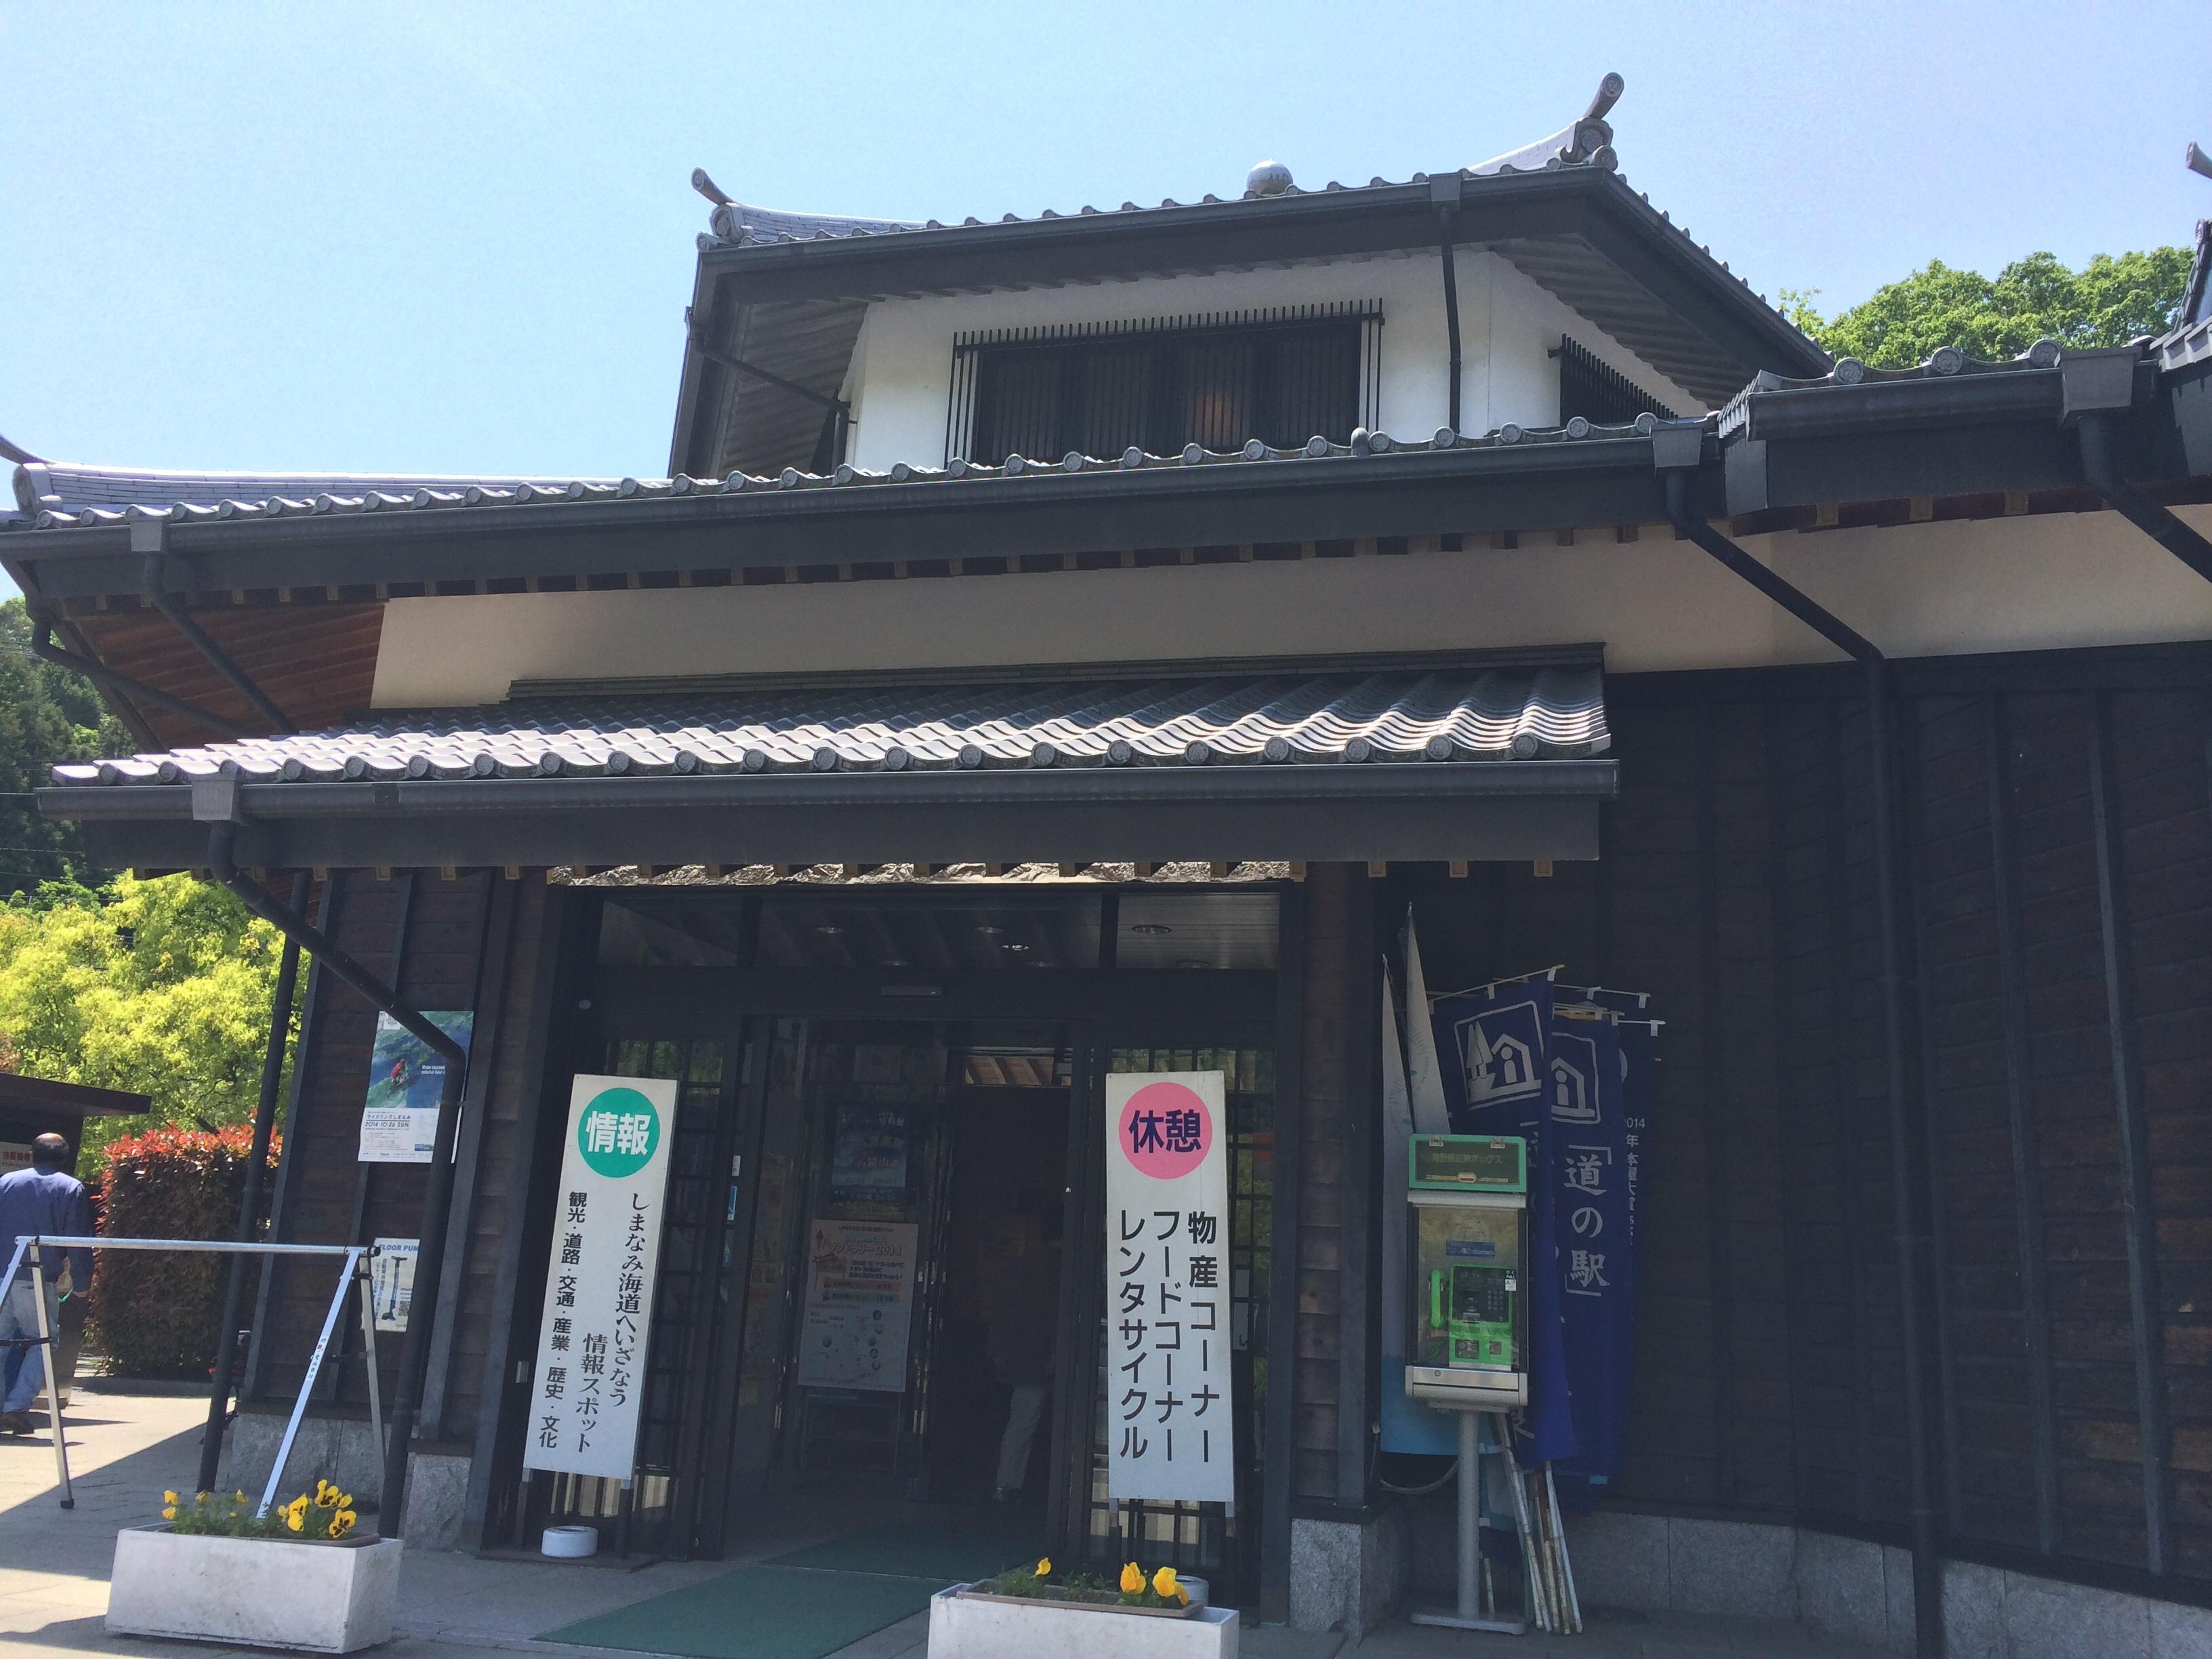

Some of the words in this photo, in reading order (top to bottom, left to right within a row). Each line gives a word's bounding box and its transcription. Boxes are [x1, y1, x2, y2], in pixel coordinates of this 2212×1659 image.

[586, 1111, 651, 1156] 情報
[1128, 1109, 1202, 1153] 休憩
[576, 1333, 609, 1453] 情報スポット
[609, 1192, 650, 1408] しまなみ海道へいざなう
[1120, 1210, 1149, 1459] レンタサイクル
[1153, 1211, 1183, 1461] フードコーナー
[1188, 1211, 1220, 1462] 物産コーナー
